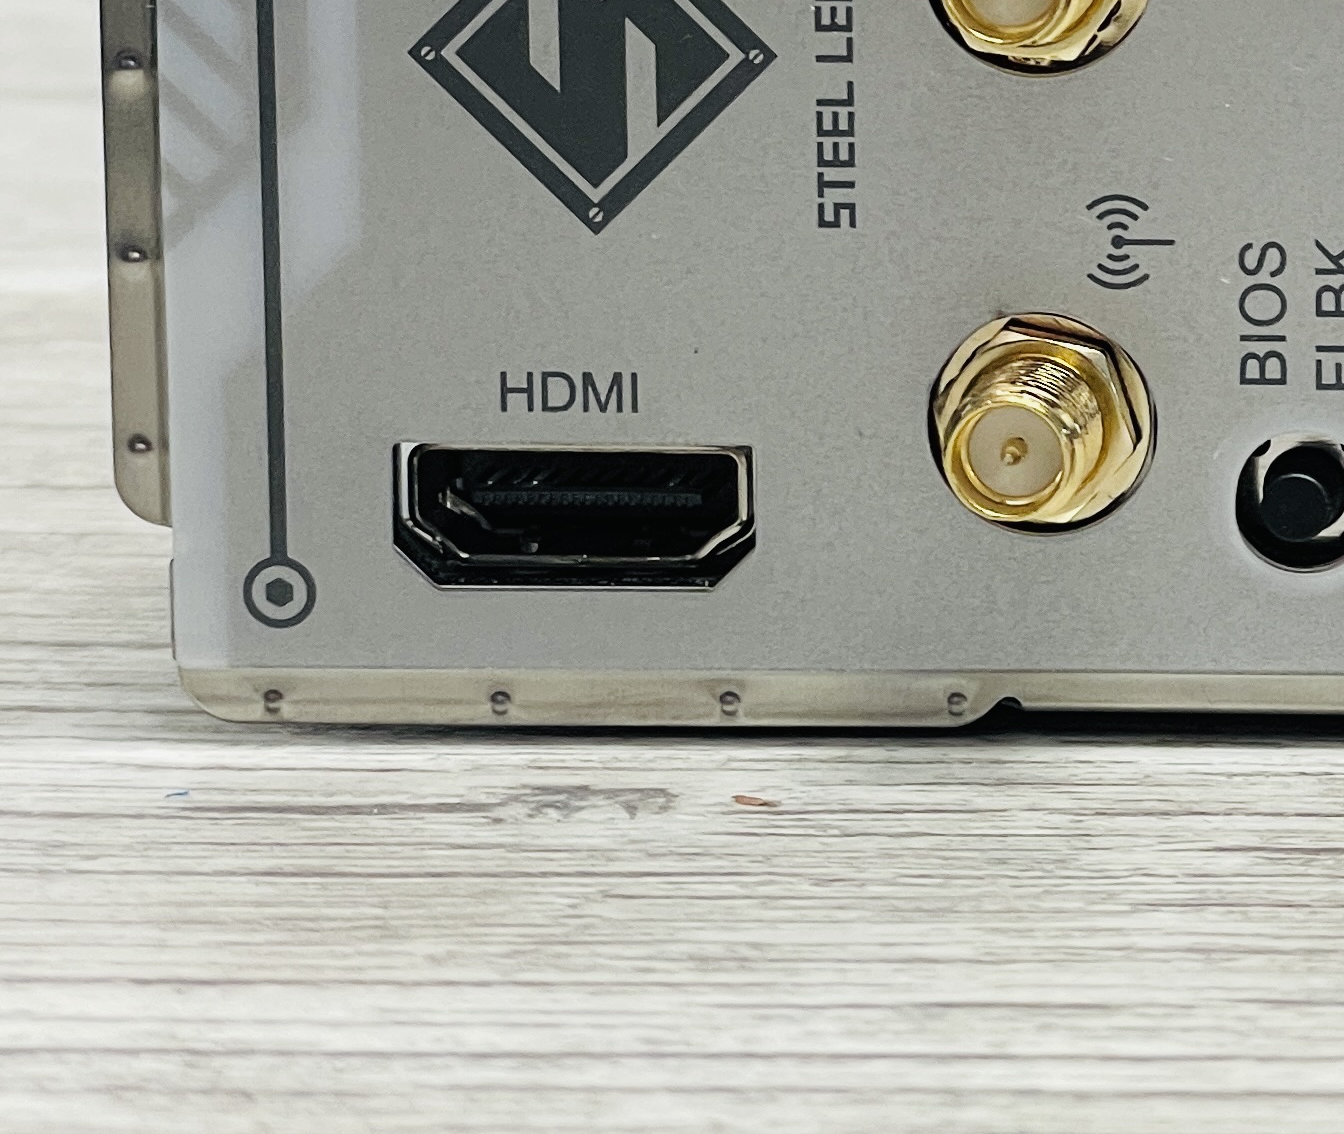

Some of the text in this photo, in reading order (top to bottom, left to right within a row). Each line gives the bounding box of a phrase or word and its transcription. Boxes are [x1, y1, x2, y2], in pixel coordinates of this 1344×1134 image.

[815, 80, 857, 229] STEEL
[1238, 241, 1289, 387] BIOS
[499, 370, 640, 414] HDMI
